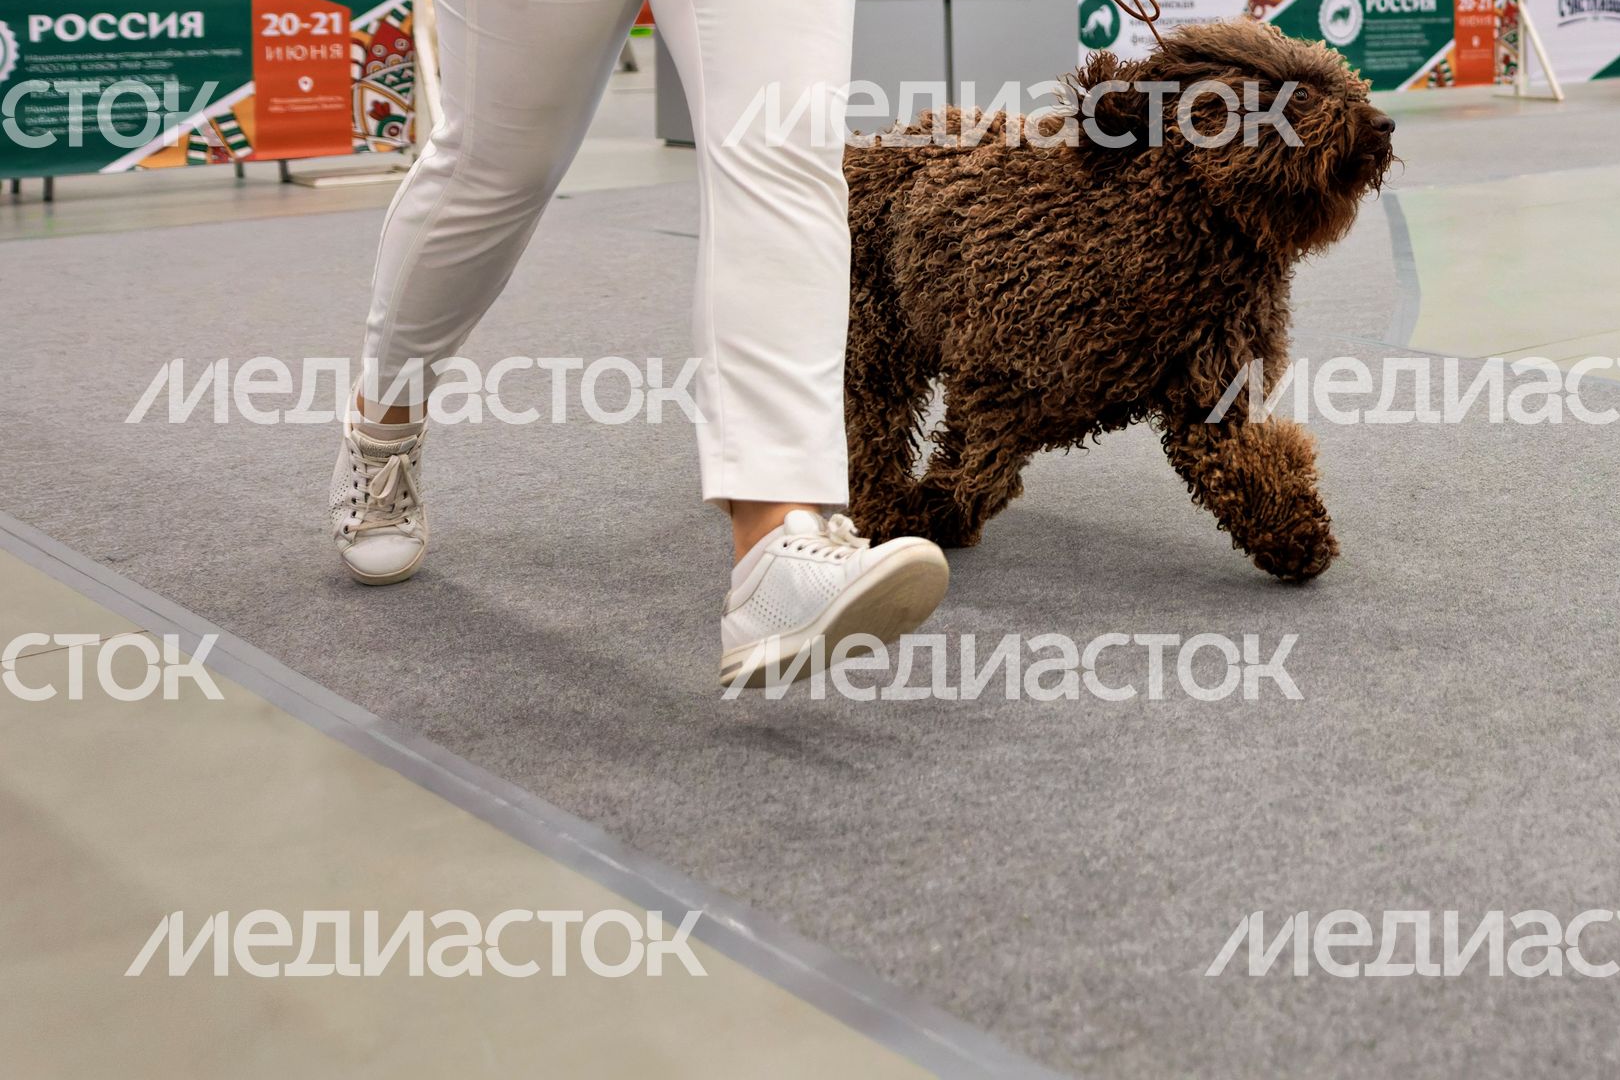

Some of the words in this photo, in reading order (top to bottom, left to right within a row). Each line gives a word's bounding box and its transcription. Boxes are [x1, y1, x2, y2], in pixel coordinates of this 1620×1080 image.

[28, 11, 204, 43] РОССИЯ
[262, 12, 343, 37] 20-21
[265, 43, 344, 62] ИЮНЯ
